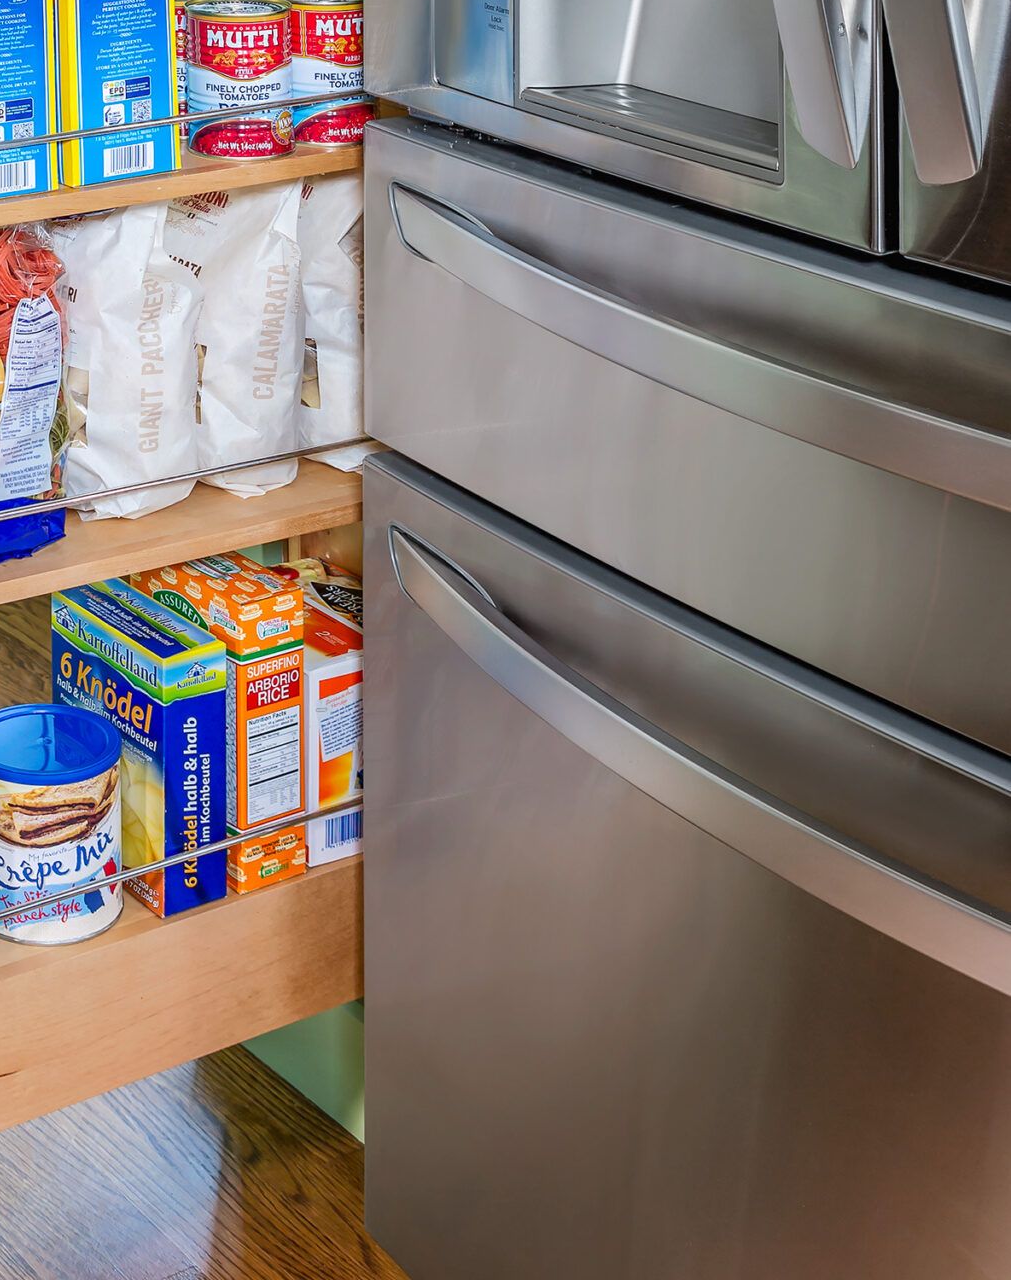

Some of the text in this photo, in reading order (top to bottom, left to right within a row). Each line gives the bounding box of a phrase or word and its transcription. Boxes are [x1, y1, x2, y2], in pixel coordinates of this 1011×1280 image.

[483, 2, 495, 12] Door
[490, 15, 502, 24] Lock
[206, 29, 278, 48] MUTTI
[314, 72, 347, 81] FINELY
[109, 87, 124, 95] EPD
[206, 82, 281, 92] FINELY CHOPPED
[218, 92, 270, 101] TOMATOES
[328, 127, 340, 136] Net
[341, 129, 350, 137] Wt
[218, 141, 274, 151] Net Wt 14oz (400g)
[252, 264, 290, 400] CALAMARATA
[139, 387, 164, 454] GIANT
[159, 593, 201, 628] ASSURED
[322, 593, 362, 613] REAM
[77, 619, 158, 688] Kartoffelland
[246, 654, 300, 679] SUPERFINO
[176, 672, 217, 690] Kartoffelland
[247, 669, 299, 696] ARBORIO
[60, 652, 153, 734] 6 Knödel
[257, 685, 290, 706] RICE
[56, 674, 73, 693] halb
[73, 687, 80, 698] &
[79, 691, 96, 711] halb
[111, 714, 157, 753] Kochbeutel
[249, 711, 287, 726] Nutrition Facts
[183, 716, 198, 755] halb
[183, 757, 198, 771] &
[183, 779, 198, 812] halb
[200, 753, 210, 842] im Kochbeutel
[29, 847, 69, 861] My favorite
[75, 825, 114, 872] Mix
[139, 880, 149, 891] 200
[184, 876, 198, 888] 6
[51, 899, 83, 923] style
